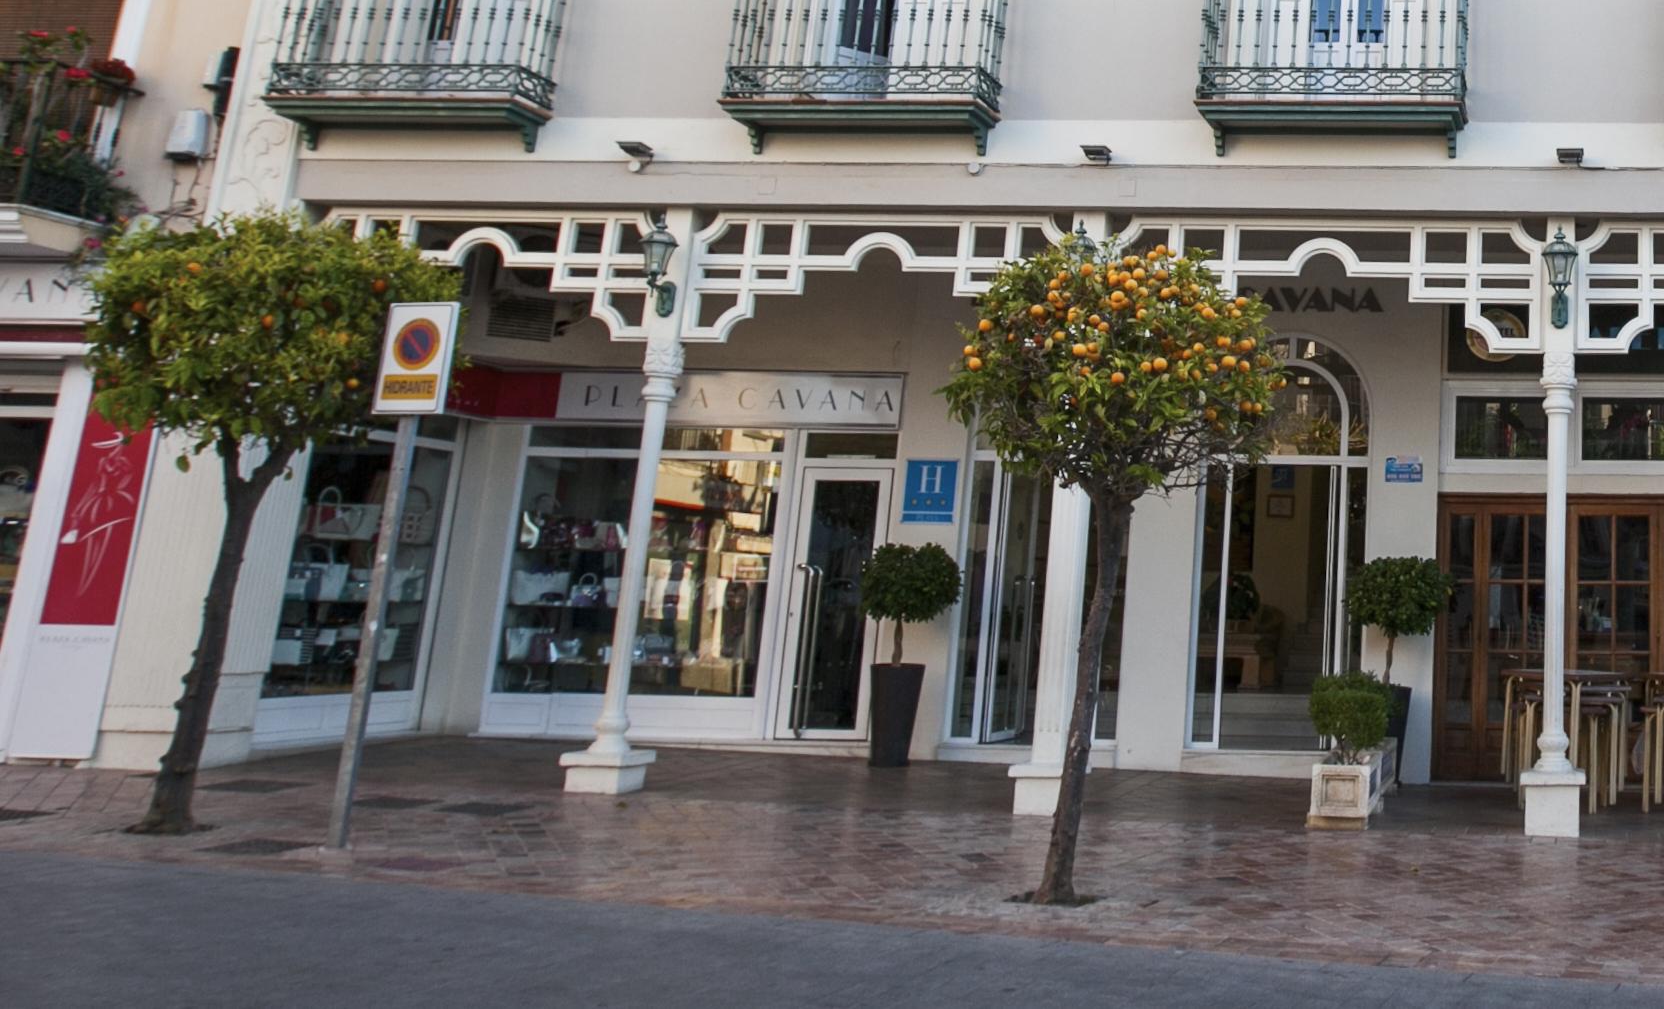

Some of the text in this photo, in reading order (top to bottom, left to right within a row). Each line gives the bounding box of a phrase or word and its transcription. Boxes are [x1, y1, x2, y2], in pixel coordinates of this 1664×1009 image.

[384, 380, 434, 395] HIDRANTE
[738, 387, 894, 412] CAVANA
[918, 465, 945, 494] H
